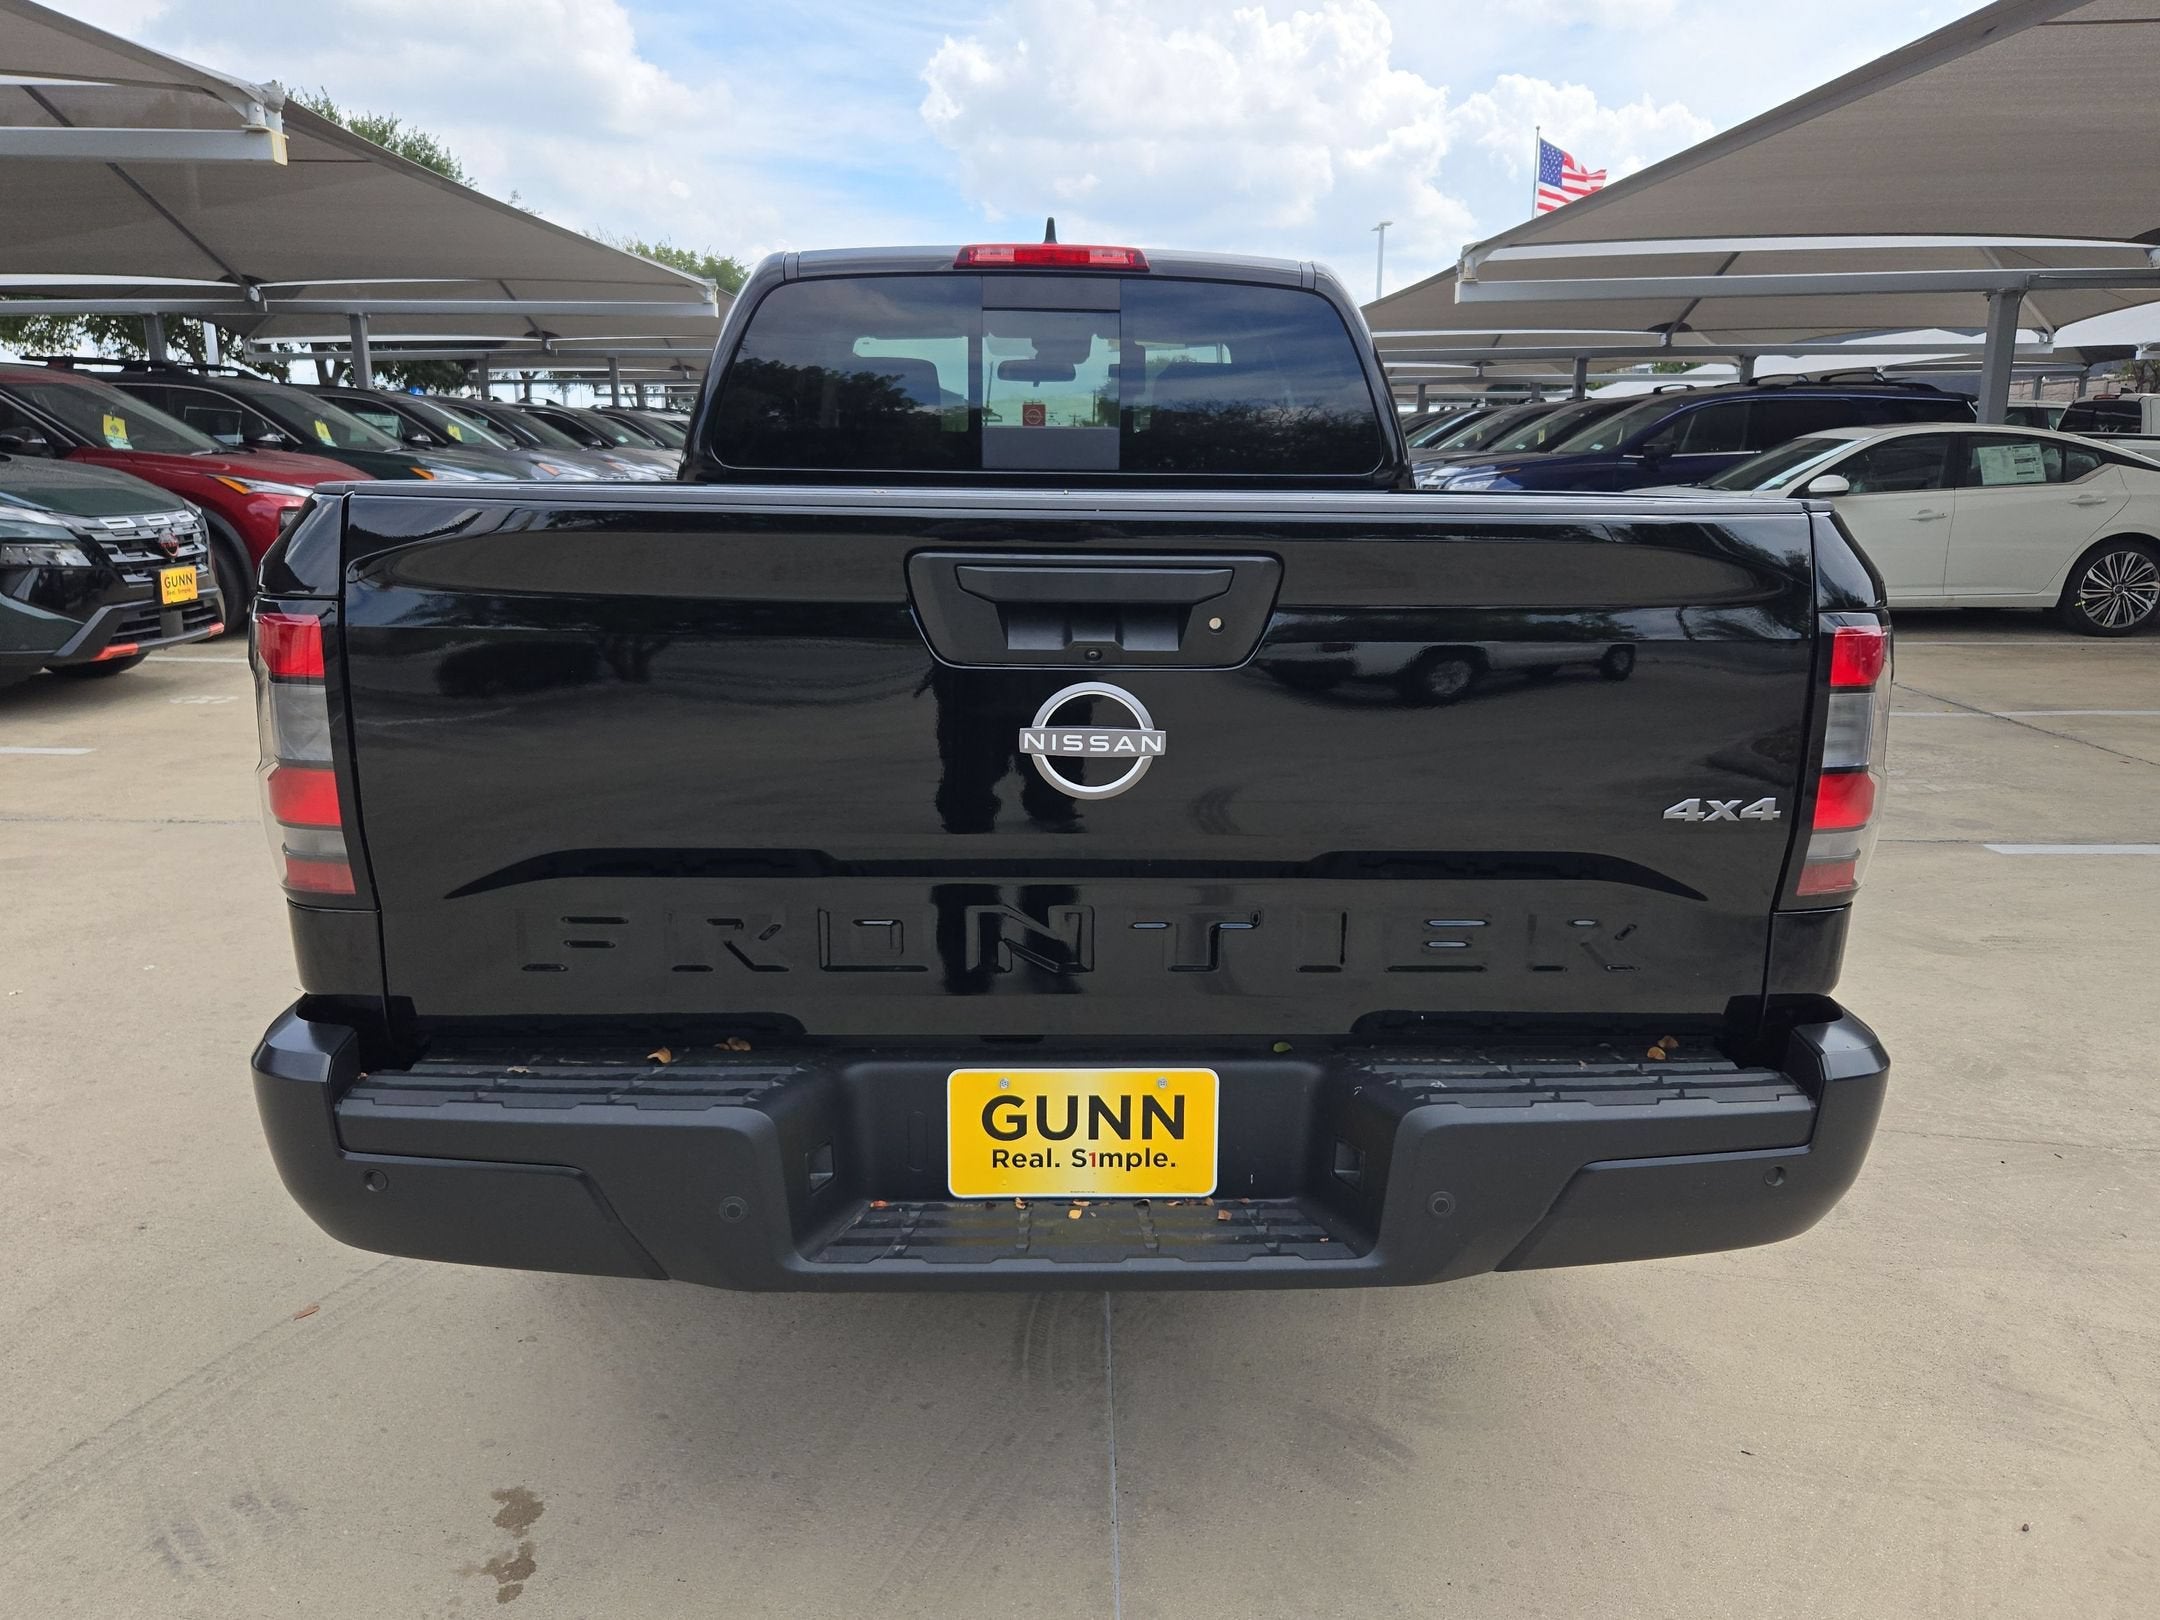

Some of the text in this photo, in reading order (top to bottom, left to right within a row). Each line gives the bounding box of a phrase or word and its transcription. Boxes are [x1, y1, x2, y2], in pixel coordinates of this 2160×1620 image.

[164, 573, 193, 589] GUNN
[1023, 732, 1162, 753] NISSAN
[517, 904, 1640, 973] FRONTIER
[981, 1094, 1186, 1142] GUNN
[991, 1148, 1061, 1169] Real.
